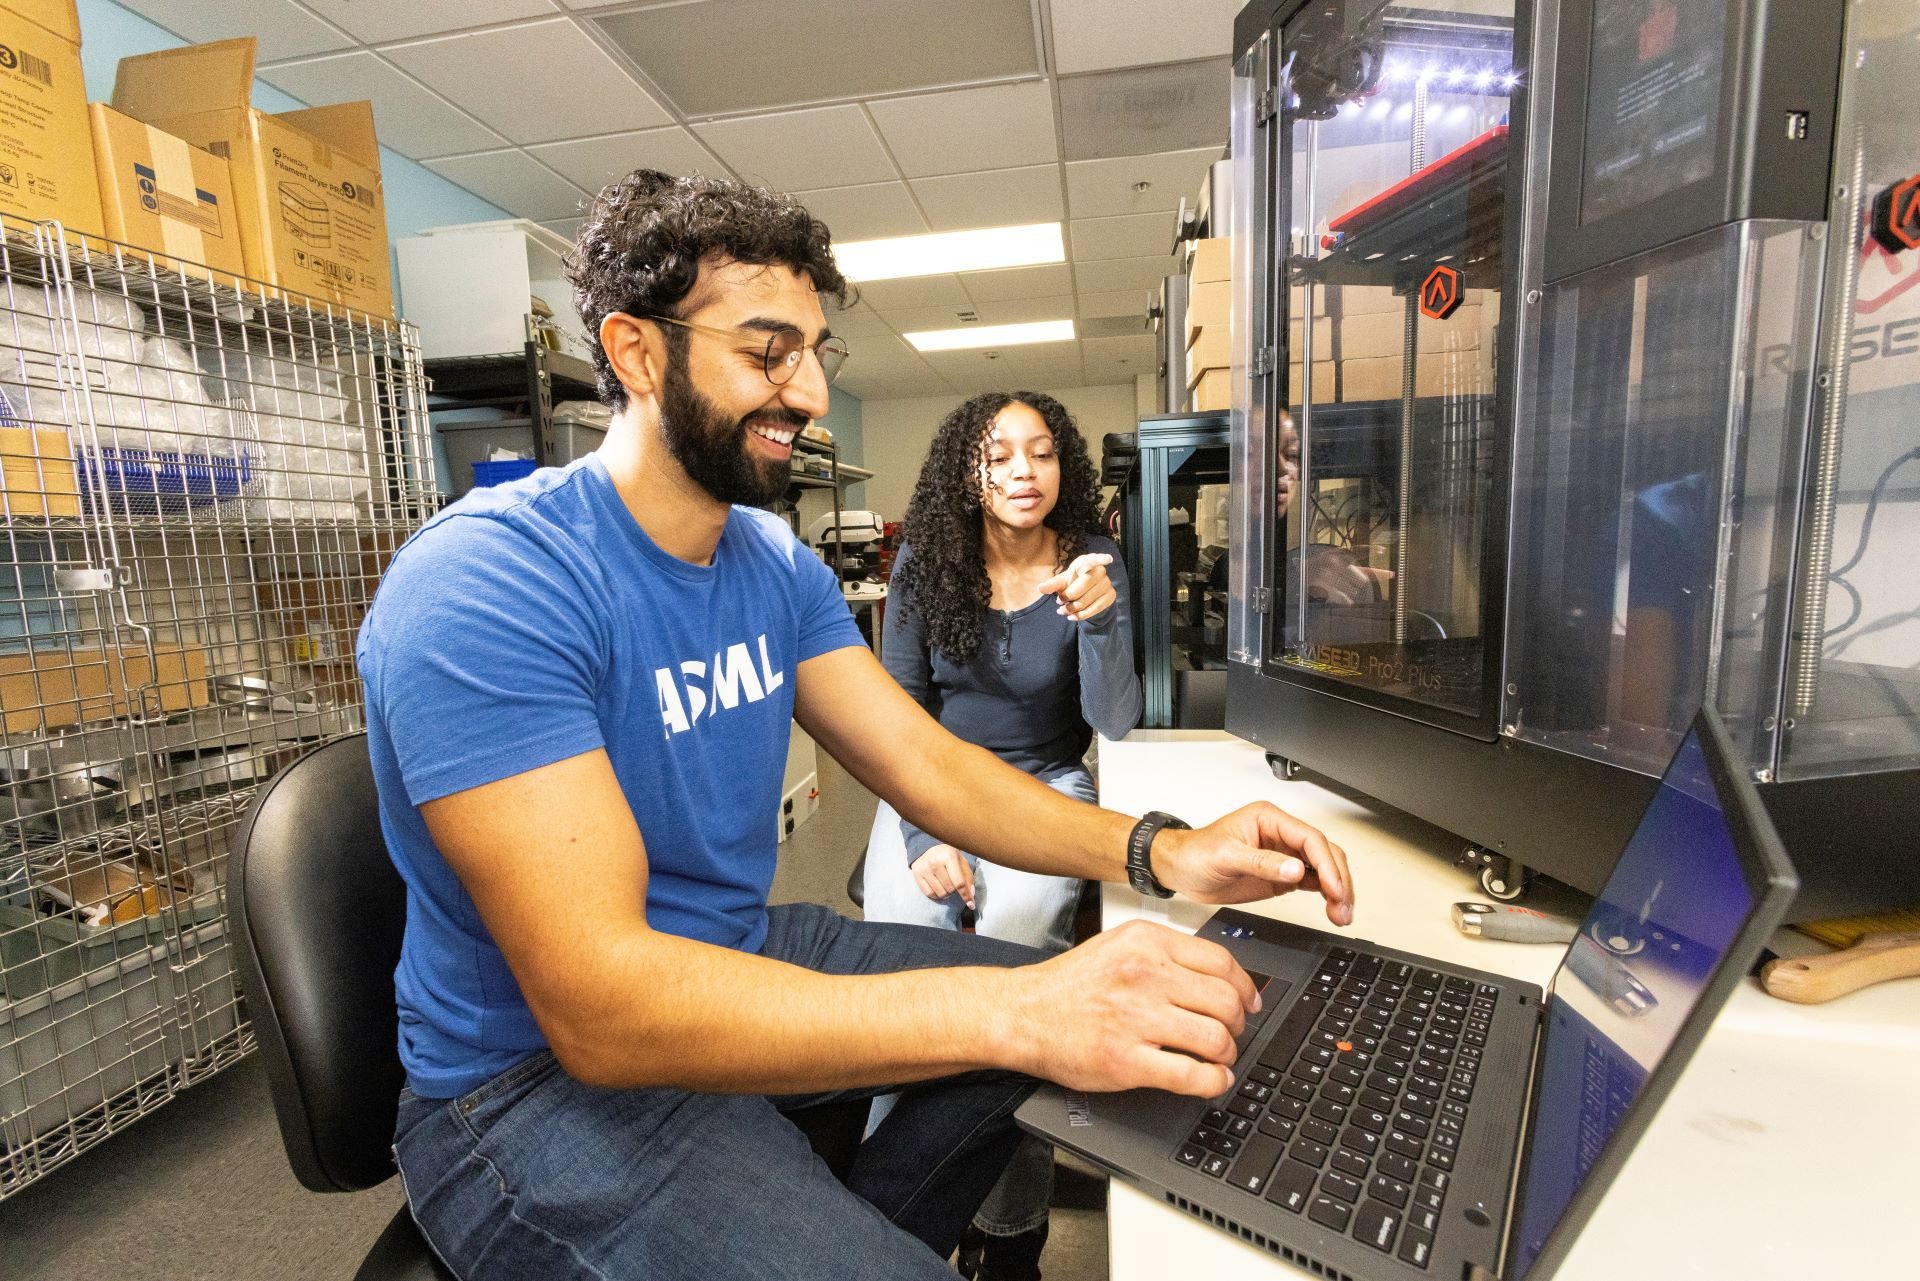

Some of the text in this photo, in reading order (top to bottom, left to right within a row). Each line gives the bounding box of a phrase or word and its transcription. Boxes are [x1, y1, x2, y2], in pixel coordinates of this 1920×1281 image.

[274, 159, 307, 180] Filament
[308, 174, 328, 189] Dryer
[1408, 663, 1441, 690] Plus
[655, 633, 784, 740] ASML
[1310, 1066, 1321, 1074] M
[1341, 1086, 1352, 1094] K
[1372, 1113, 1382, 1121] O
